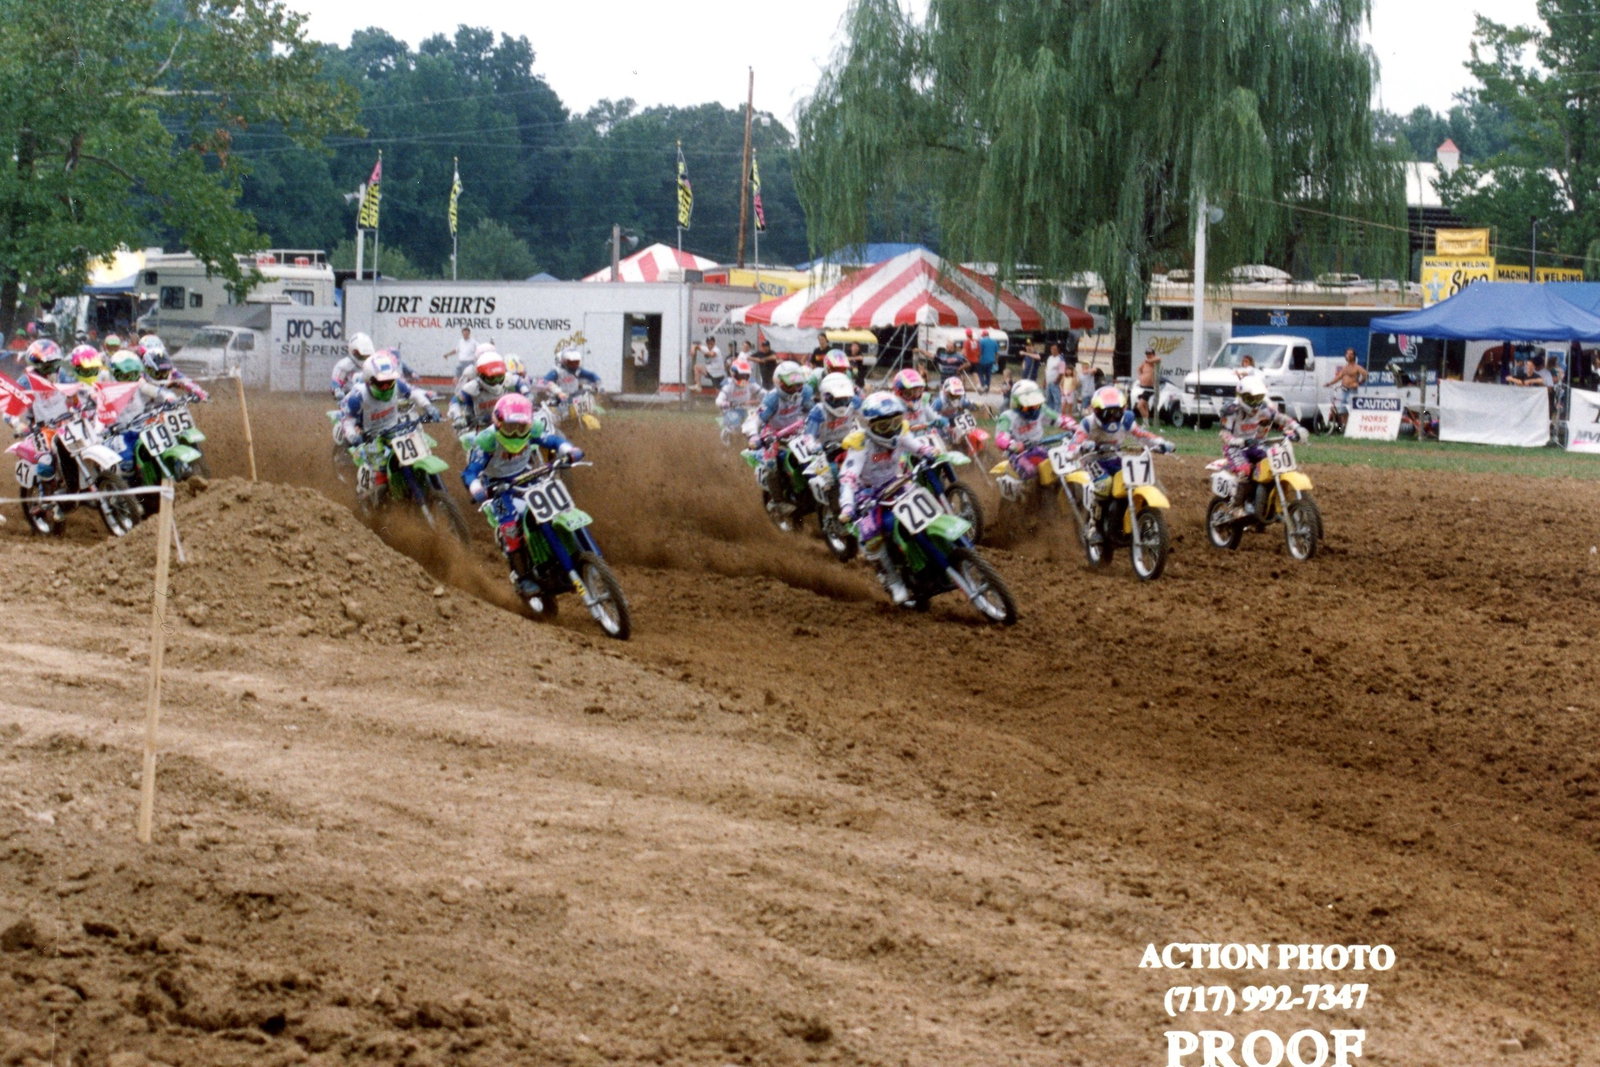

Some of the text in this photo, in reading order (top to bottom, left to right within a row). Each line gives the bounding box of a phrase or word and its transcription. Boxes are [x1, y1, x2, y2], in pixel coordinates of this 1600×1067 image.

[1498, 269, 1530, 281] MACHIN
[1543, 273, 1582, 283] WELDING
[377, 296, 496, 314] DIRT SHIRTS
[699, 302, 721, 312] DIRT
[286, 319, 342, 342] pro-ac
[398, 317, 571, 331] OFFICIAL APPAREL & SOUVENIRS
[281, 344, 348, 356] SUSPENS
[1356, 399, 1397, 409] CAUTION
[168, 412, 192, 433] 95
[1361, 414, 1388, 423] HORSE
[63, 419, 90, 444] 47
[146, 424, 173, 454] 49
[1359, 425, 1388, 433] TRAFFIC
[396, 438, 419, 461] 29
[1271, 450, 1292, 470] 50
[16, 462, 30, 485] 47
[1126, 460, 1151, 484] 17
[528, 481, 571, 520] 90
[899, 494, 937, 530] 20
